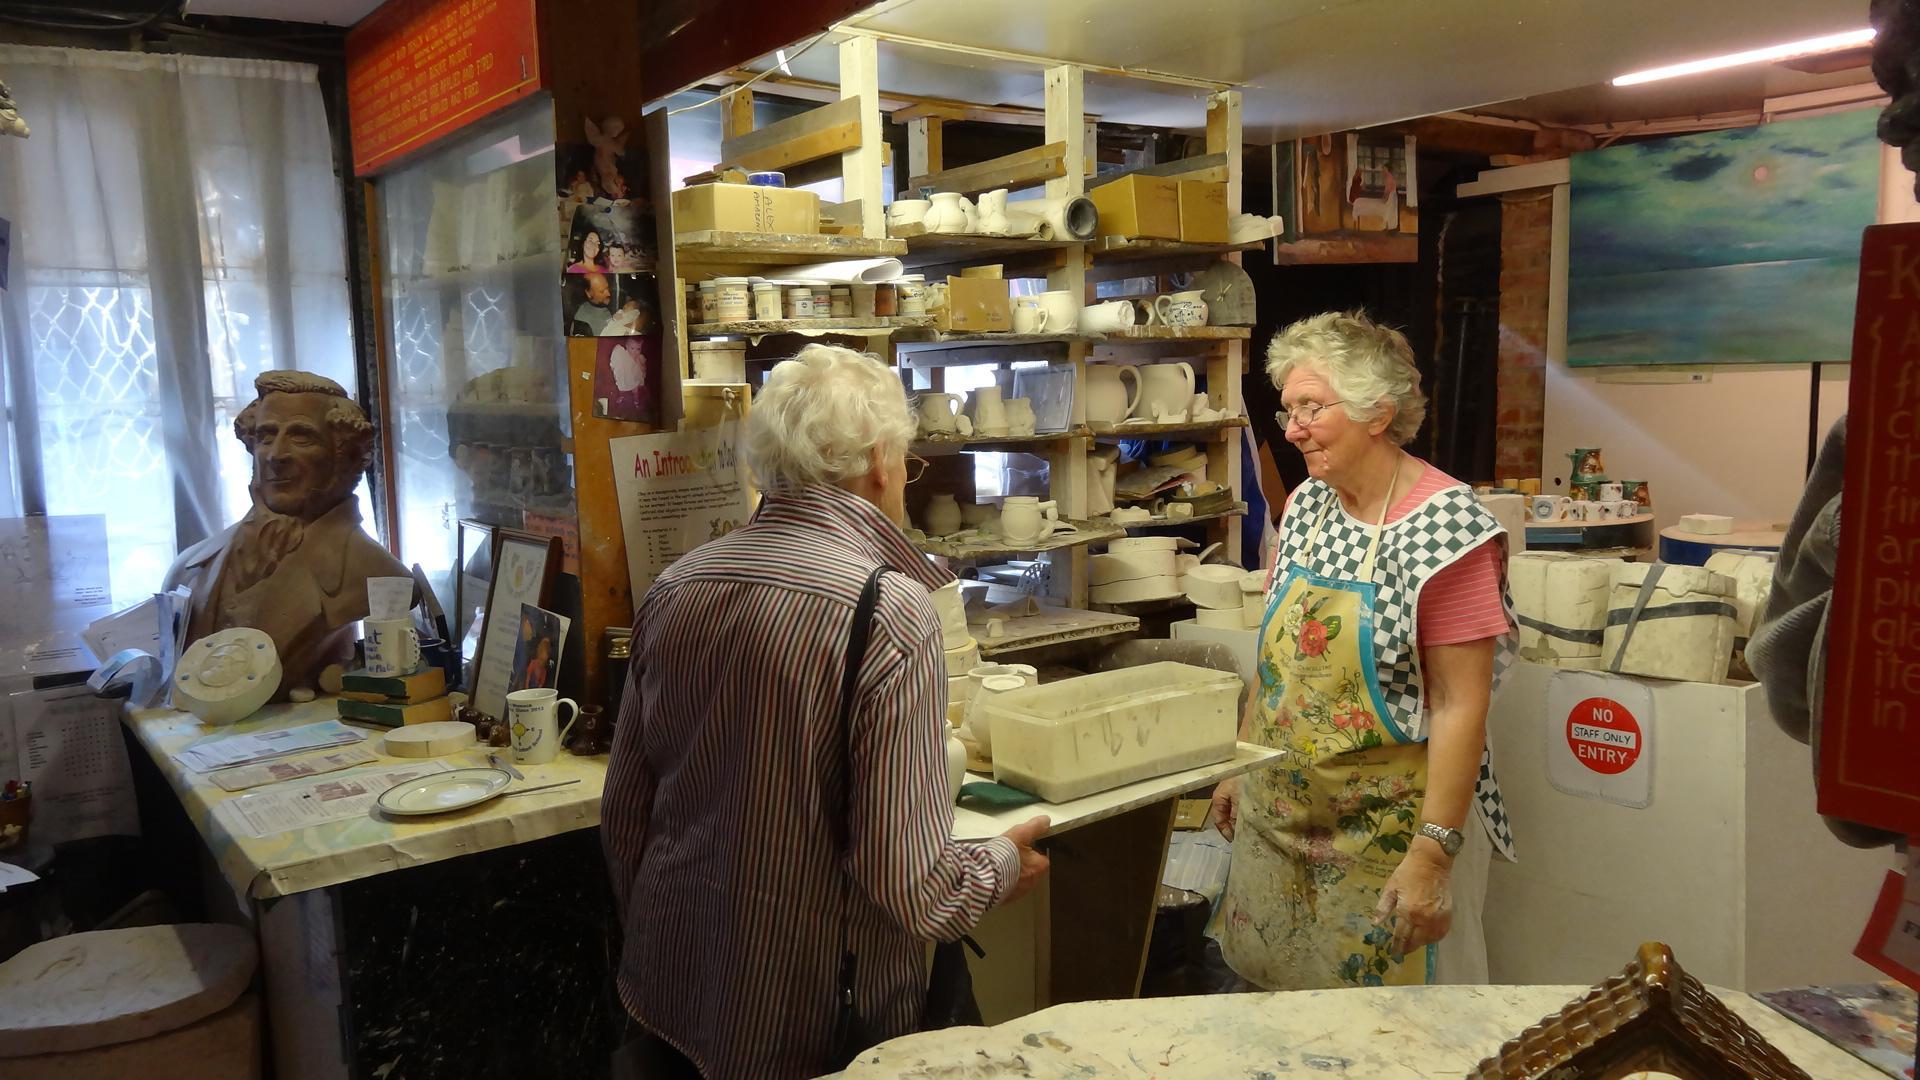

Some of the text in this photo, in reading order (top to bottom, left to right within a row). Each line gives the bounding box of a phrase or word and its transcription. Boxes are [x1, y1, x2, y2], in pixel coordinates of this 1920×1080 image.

[635, 453, 651, 478] An
[1593, 707, 1614, 723] NO
[1574, 726, 1631, 745] STAFF ONLY
[1578, 744, 1628, 765] ENTRY
